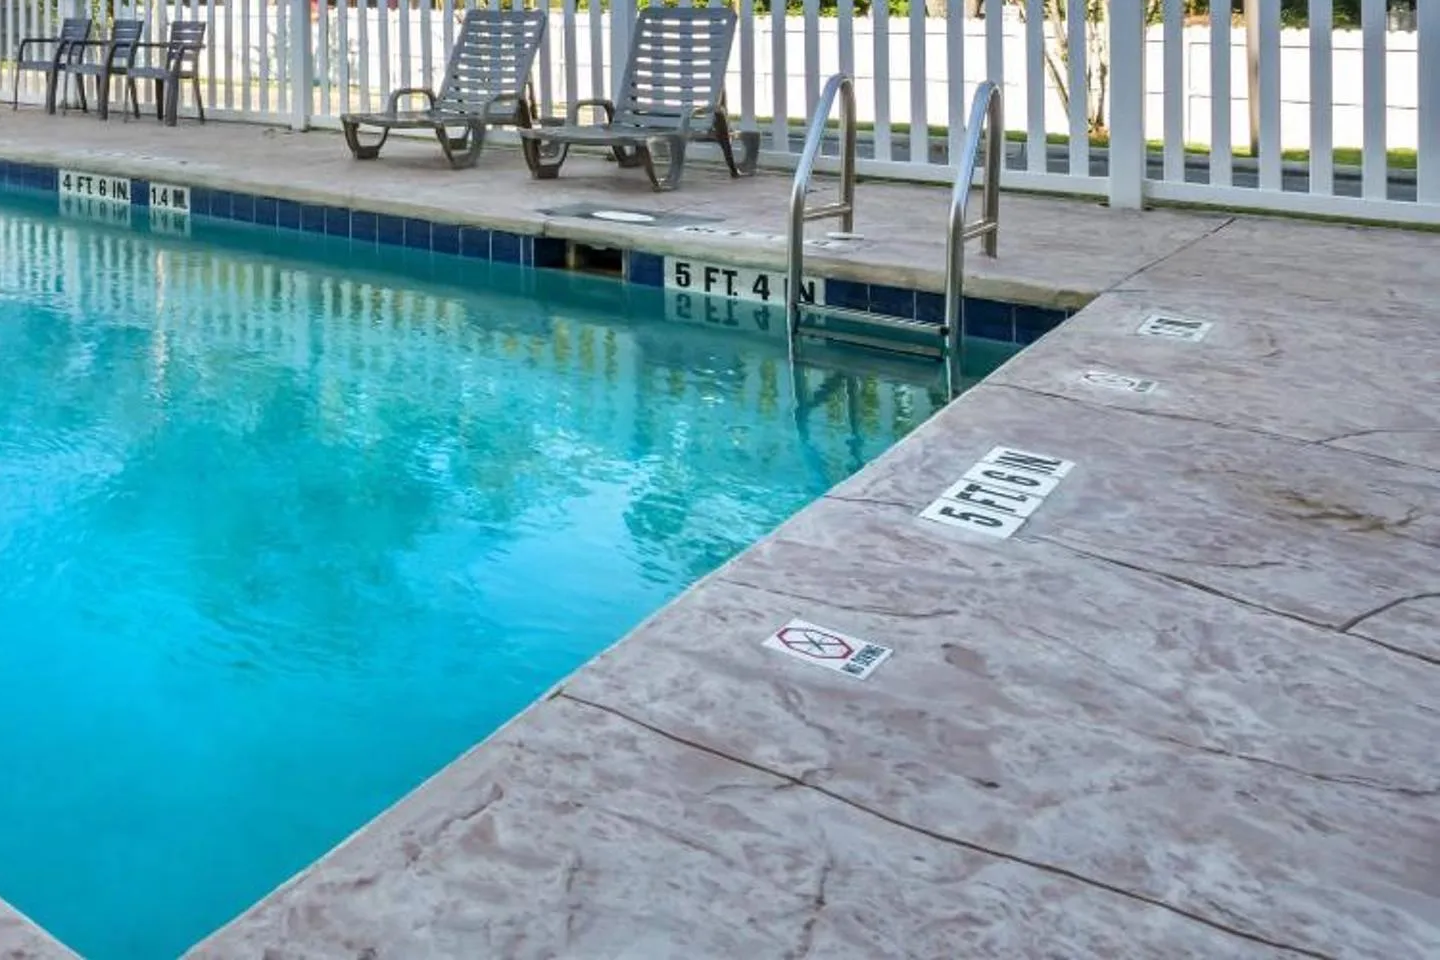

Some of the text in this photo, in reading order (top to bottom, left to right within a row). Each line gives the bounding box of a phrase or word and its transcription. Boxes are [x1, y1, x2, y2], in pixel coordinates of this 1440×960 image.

[63, 173, 72, 191] 4
[99, 178, 107, 197] 6
[151, 187, 168, 207] 1.4
[675, 262, 691, 288] 5
[704, 266, 739, 297] FT.
[752, 273, 771, 301] 4
[939, 506, 1004, 528] 5
[982, 469, 1041, 487] 6
